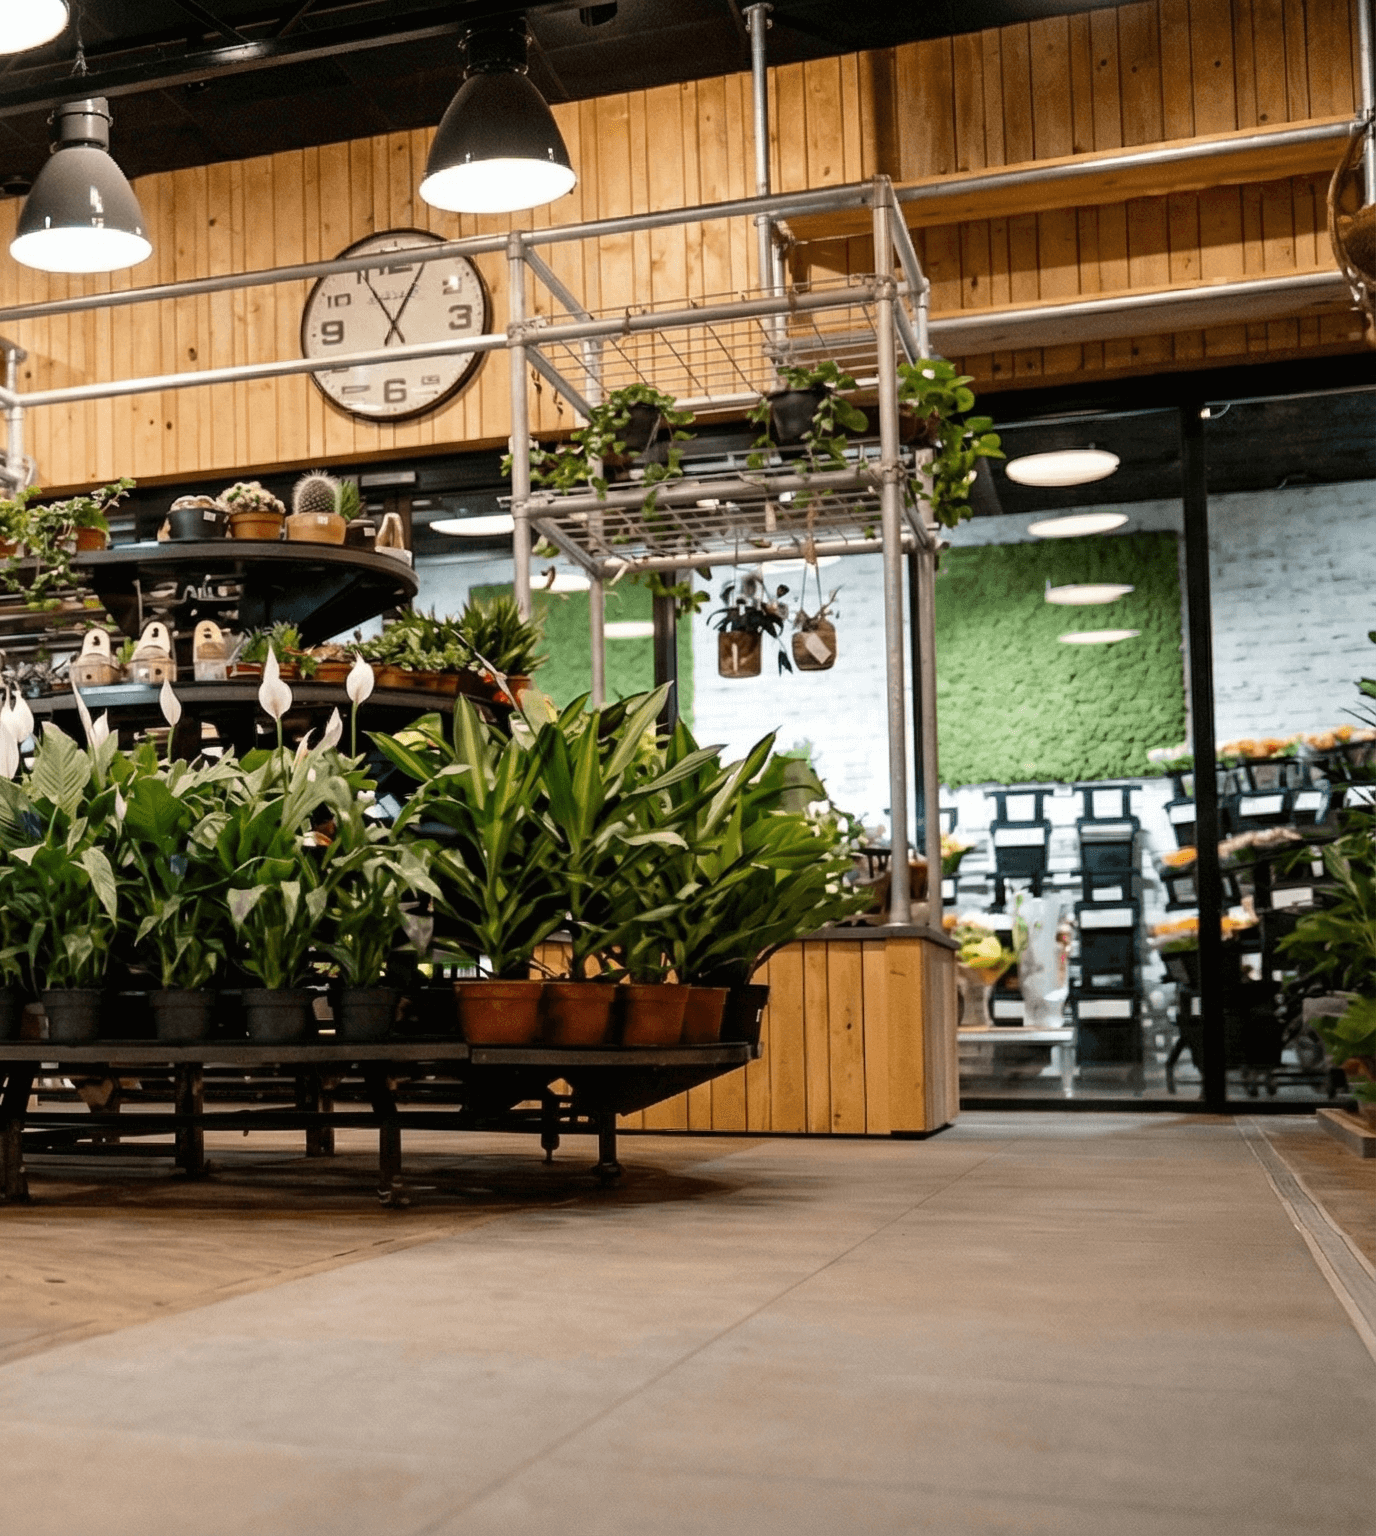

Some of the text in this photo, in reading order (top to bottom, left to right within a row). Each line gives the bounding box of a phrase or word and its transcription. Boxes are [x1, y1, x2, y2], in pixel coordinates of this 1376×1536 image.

[327, 293, 351, 308] 10
[448, 304, 472, 330] 3
[321, 320, 344, 346] 9
[384, 378, 407, 403] 6
